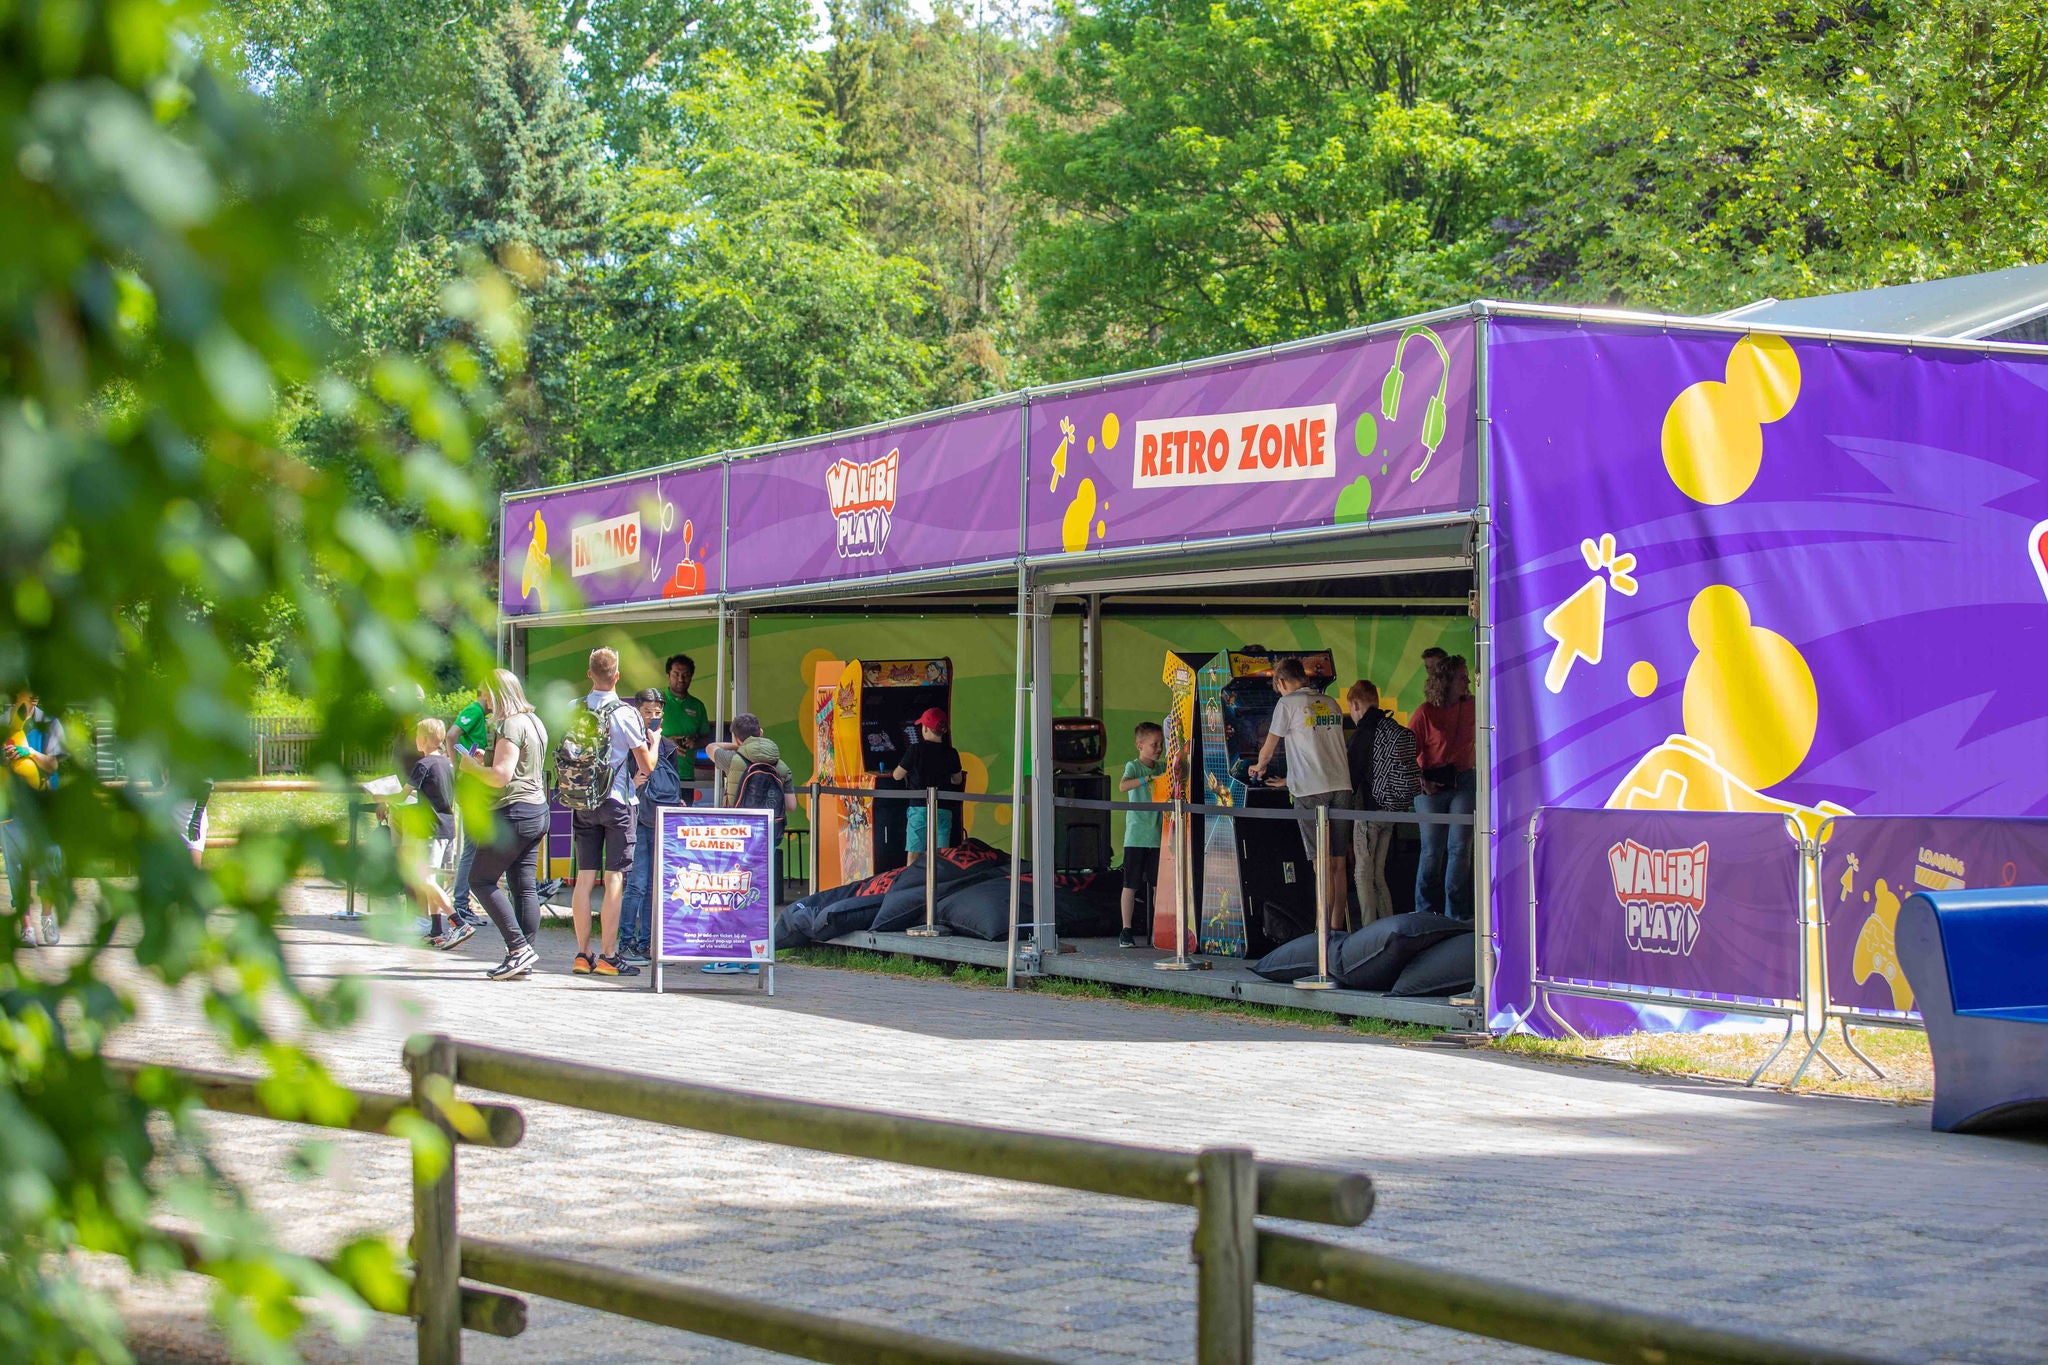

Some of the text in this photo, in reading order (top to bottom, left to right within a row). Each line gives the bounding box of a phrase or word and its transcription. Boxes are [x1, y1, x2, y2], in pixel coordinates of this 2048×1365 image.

[1140, 418, 1327, 477] RETRO ZONE
[838, 510, 878, 548] PLAY
[720, 827, 748, 836] OOK
[690, 892, 733, 906] PLAY
[1627, 903, 1683, 944] PLAY
